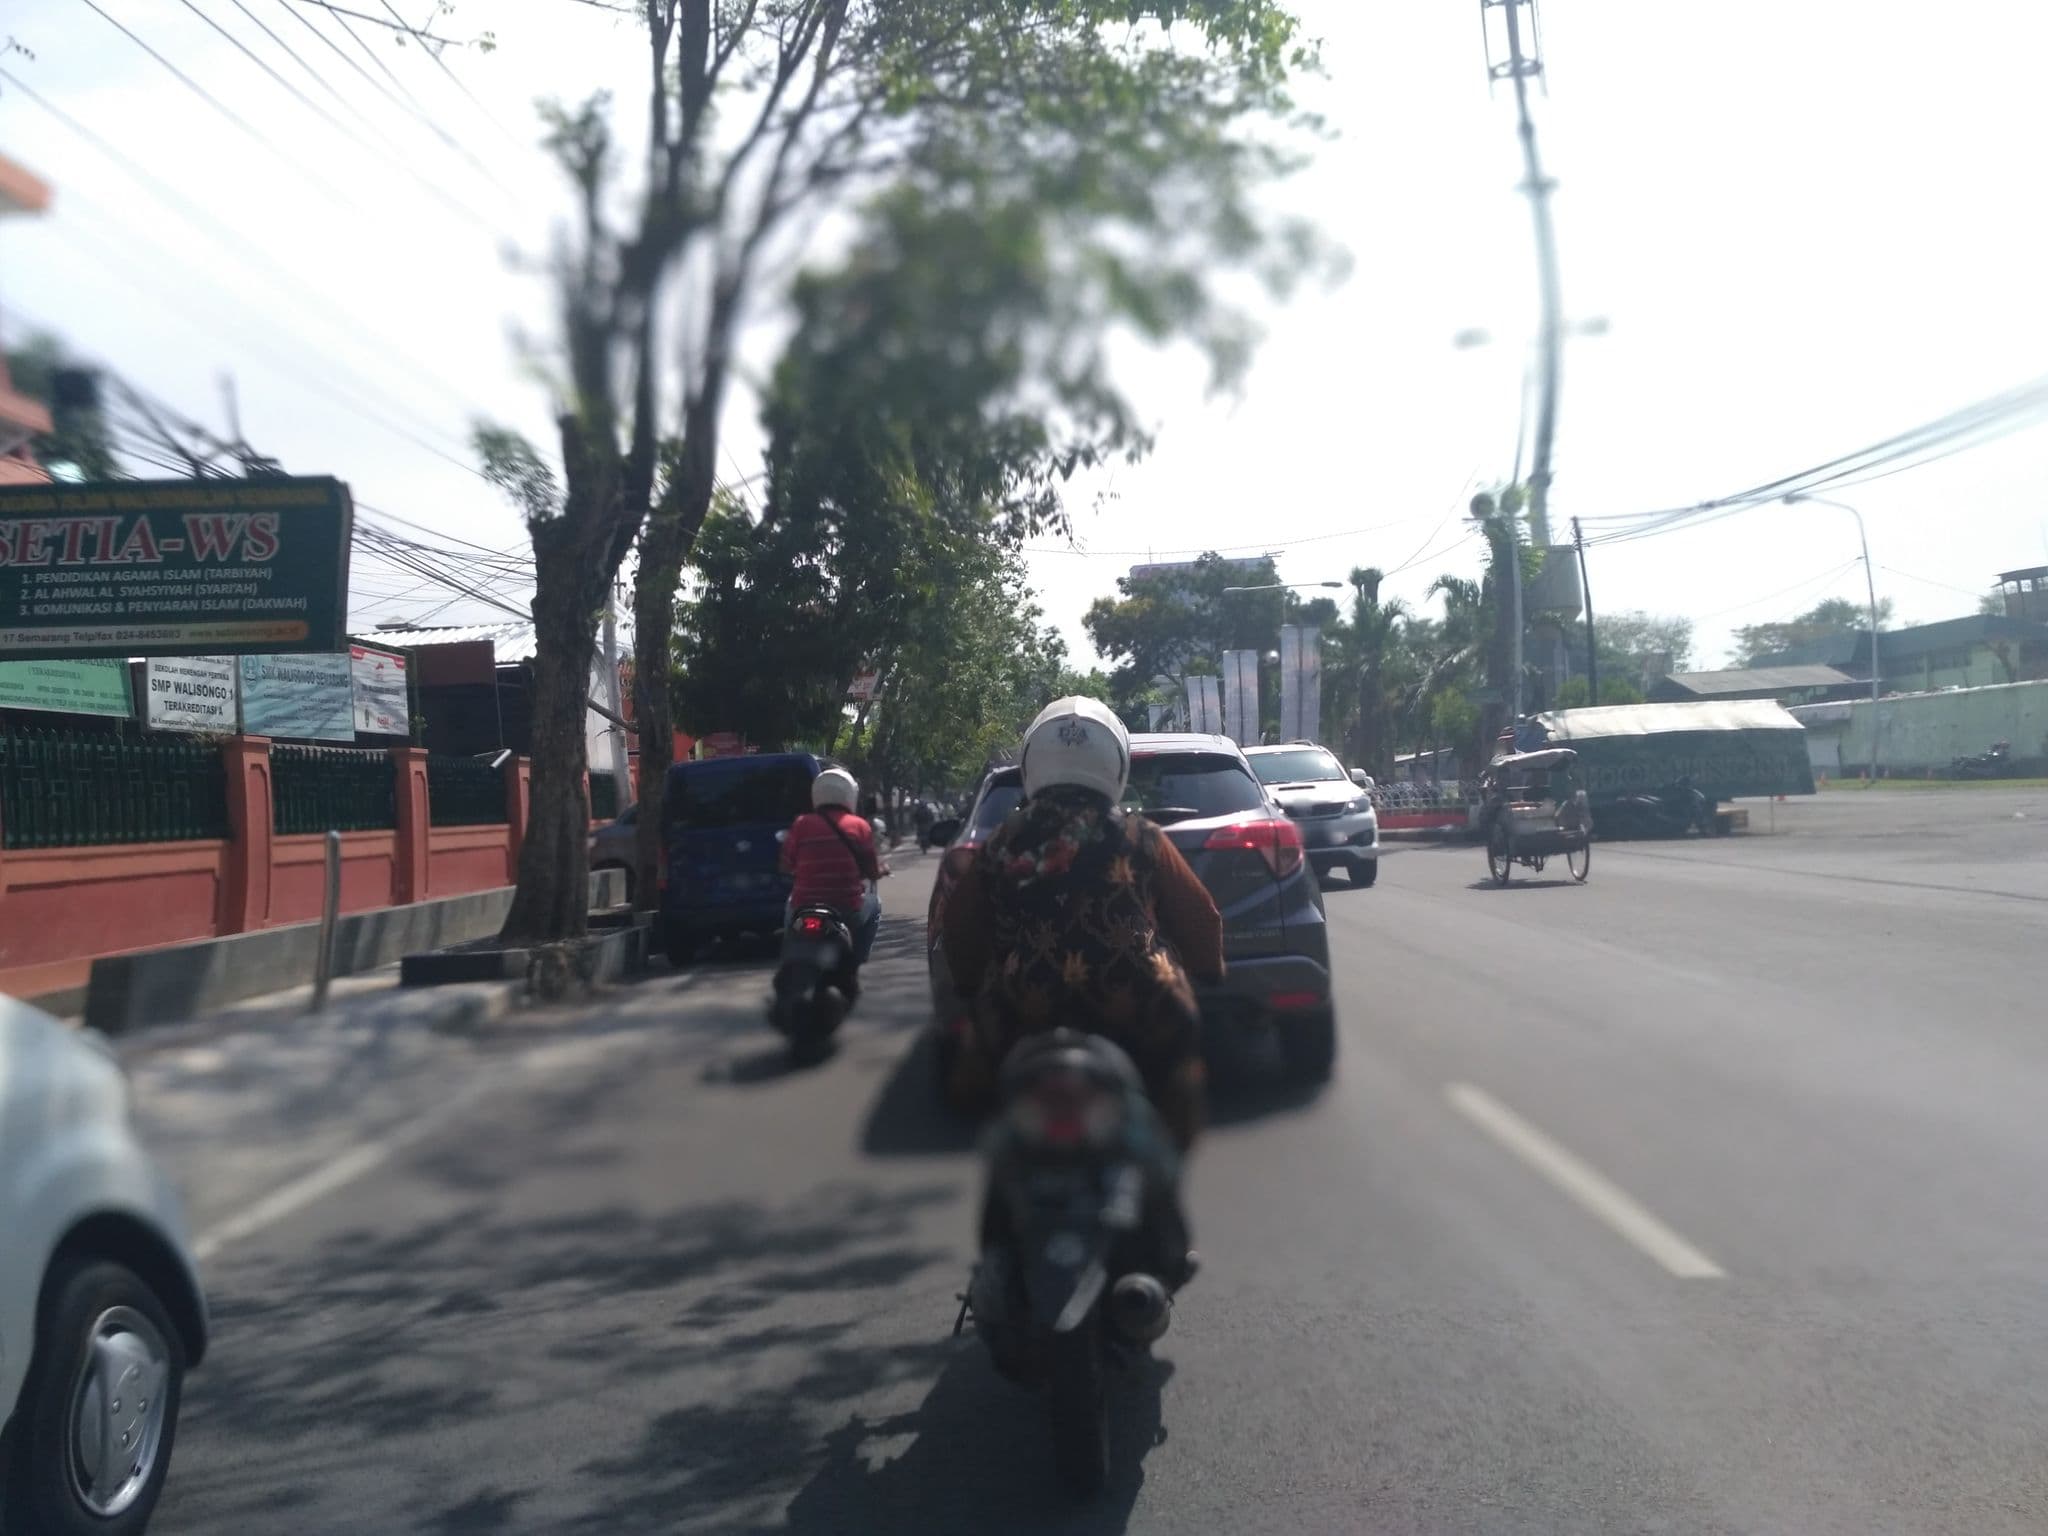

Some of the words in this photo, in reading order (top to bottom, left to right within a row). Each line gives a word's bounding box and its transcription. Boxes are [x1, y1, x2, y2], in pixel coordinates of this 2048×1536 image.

[22, 573, 32, 584] 1.
[36, 571, 110, 584] PENDIDIKAN
[112, 570, 160, 582] AGAMA
[163, 569, 200, 580] ISLAM
[204, 567, 272, 580] (TARBIYAH)
[21, 588, 31, 600] 2.
[34, 587, 49, 599] AL
[52, 586, 96, 598] AHWAL
[97, 586, 114, 598] AL
[20, 604, 30, 616] 3.
[34, 602, 112, 616] KOMUNIKASI
[115, 602, 125, 613] &
[128, 600, 198, 613] PENYIARAN
[201, 598, 239, 610] ISLAM
[243, 597, 307, 611] (DAKWAH)
[155, 664, 178, 674] SEKOLAH
[152, 678, 171, 692] SMP
[173, 681, 227, 699] WALISONGO
[229, 688, 234, 700] 1
[164, 700, 217, 715] TERAKREDITASI
